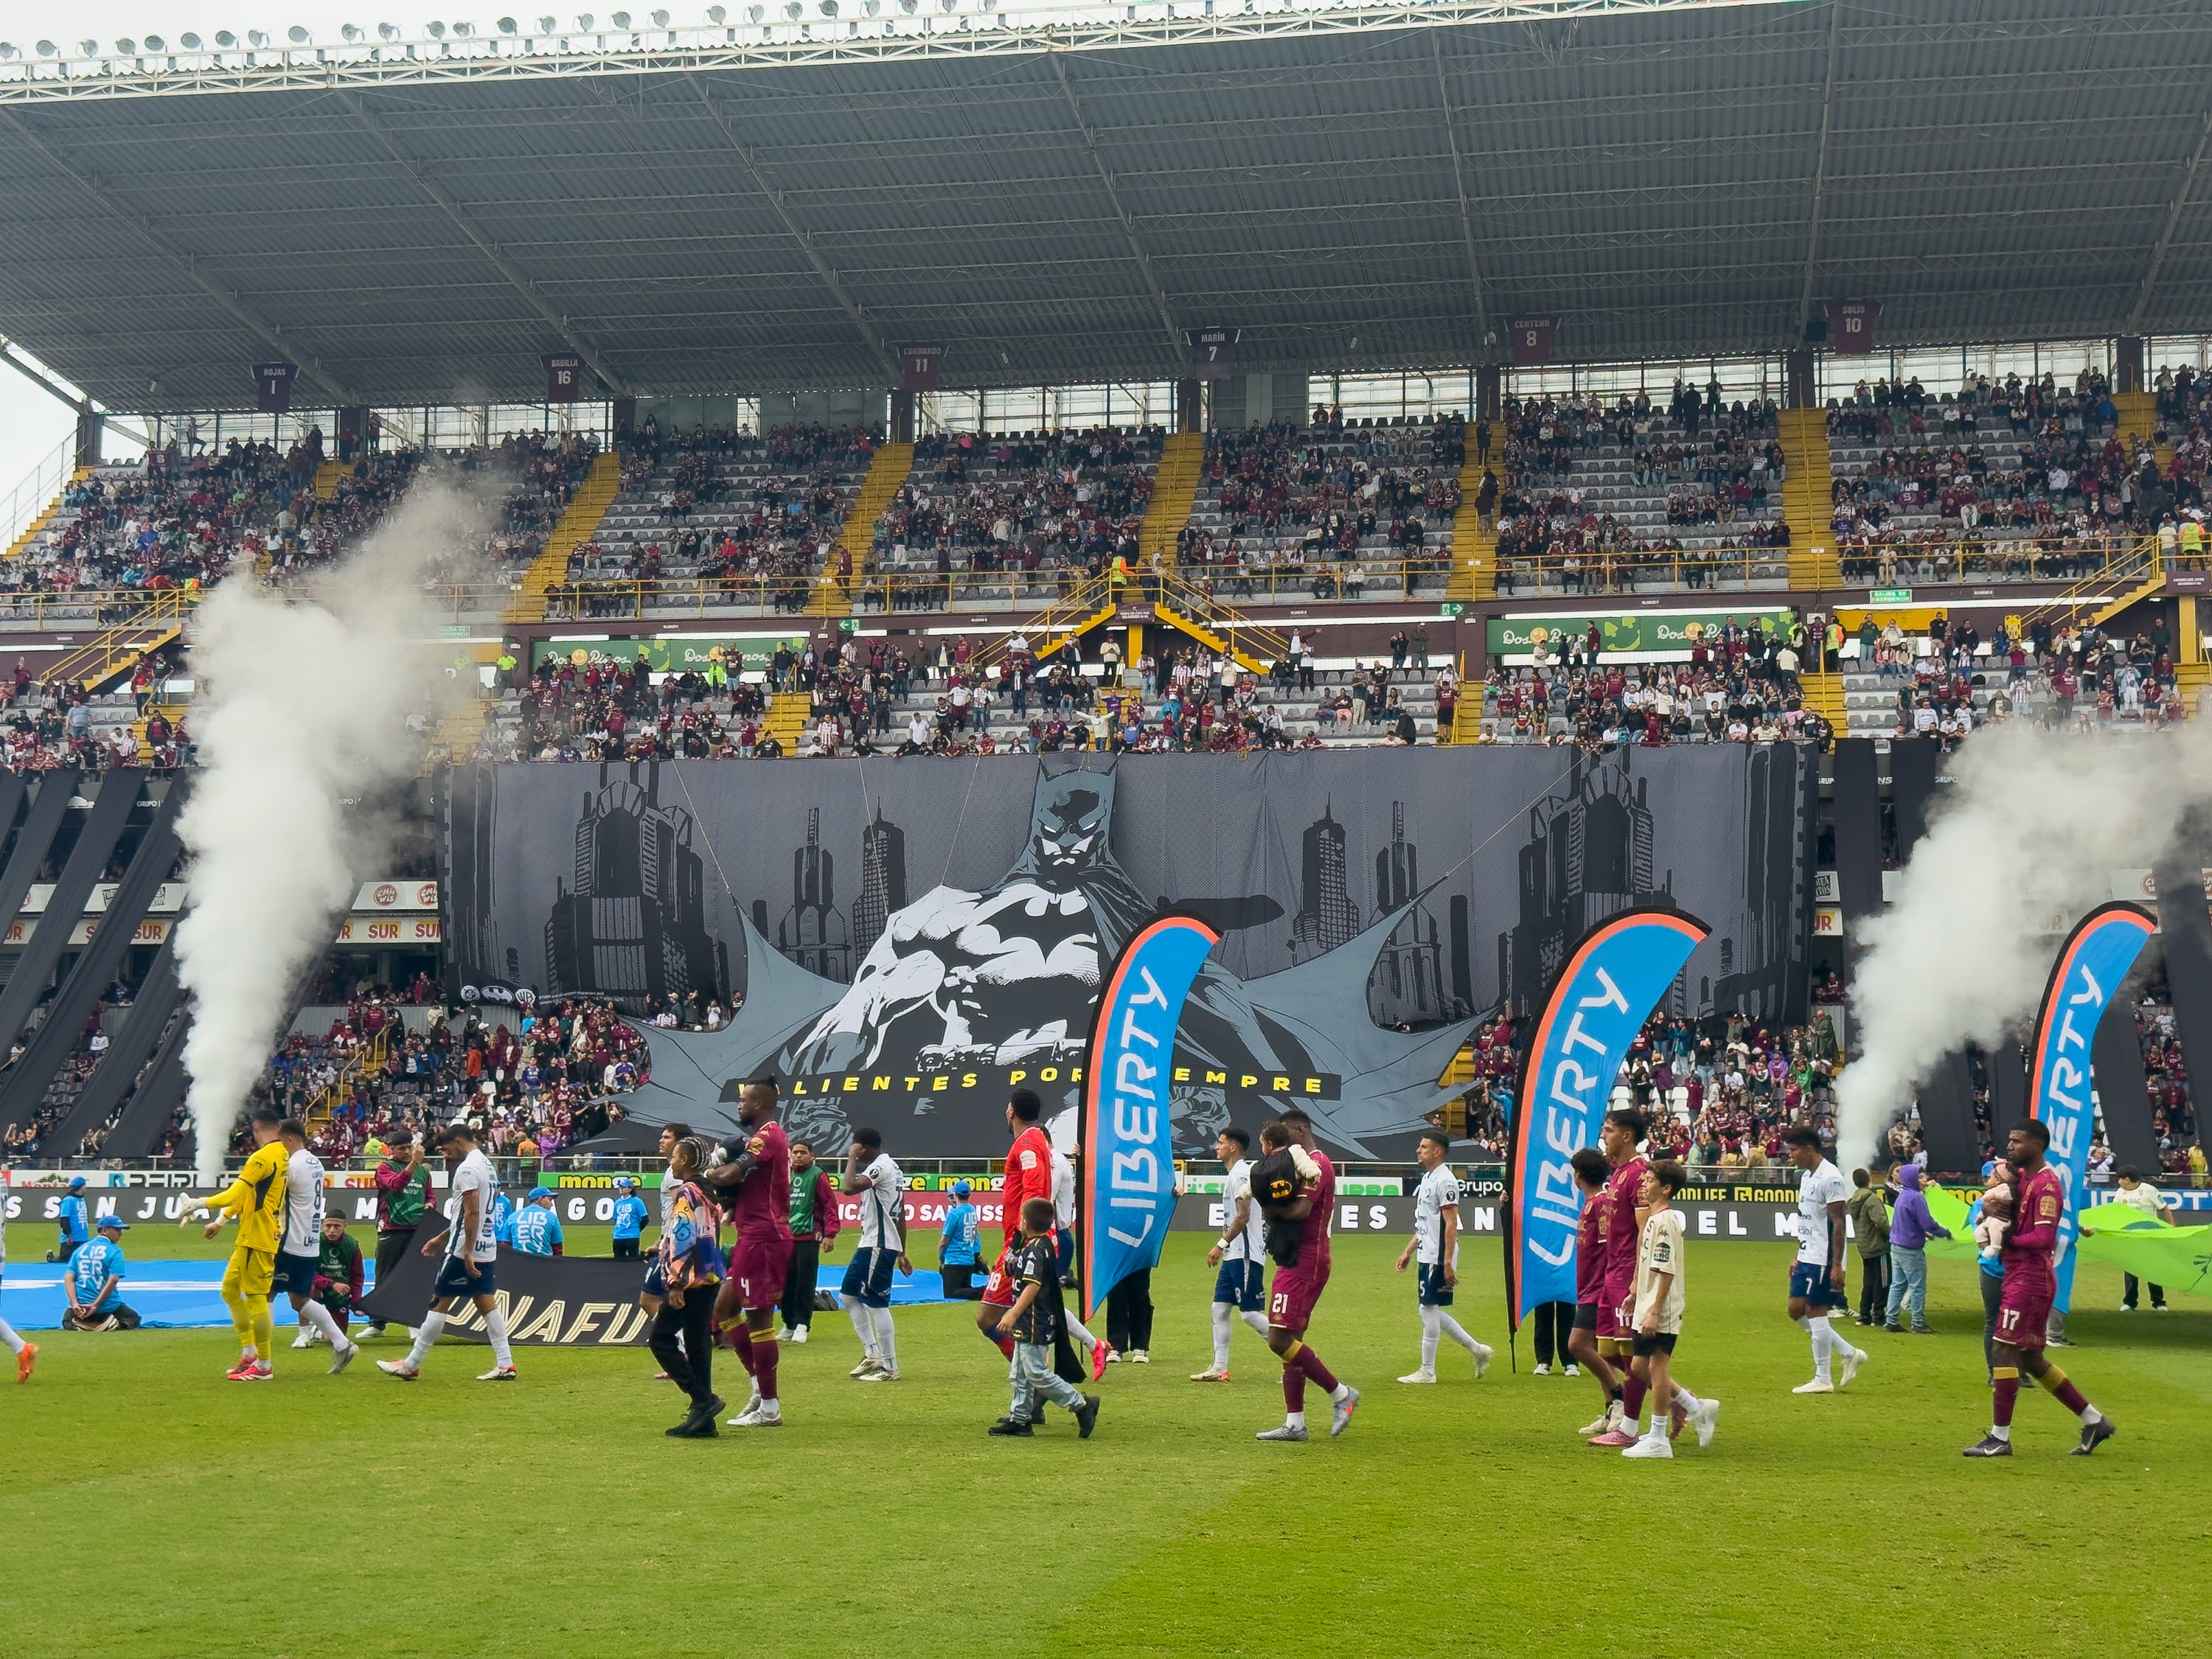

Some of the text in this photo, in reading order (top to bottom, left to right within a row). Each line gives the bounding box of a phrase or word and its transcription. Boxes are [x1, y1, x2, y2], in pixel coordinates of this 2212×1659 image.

[1846, 318, 1861, 333] 10
[1202, 331, 1225, 343] MARÍN
[1526, 330, 1537, 347] 8
[904, 347, 942, 355] CORONADO
[1208, 346, 1217, 361] 7
[264, 368, 286, 376] ROJAS
[916, 358, 928, 372] 11
[557, 370, 571, 385] 16
[1503, 630, 1532, 644] Dos
[1658, 625, 1687, 640] Dos
[548, 650, 568, 665] Do
[684, 649, 710, 662] Dos
[415, 922, 441, 939] SU
[1814, 914, 1832, 931] UR
[369, 923, 399, 939] SUR
[738, 1073, 978, 1095] LIENTES
[1175, 1068, 1321, 1093] EMPRE
[1108, 965, 1168, 1248] LIBERTY
[1528, 967, 1630, 1266] LIBERTY
[314, 1180, 321, 1210] 8
[44, 1195, 117, 1219] SN
[518, 1211, 547, 1225] LIB
[518, 1225, 546, 1240] ER
[79, 1244, 107, 1259] LIB
[78, 1259, 103, 1275] ER
[77, 1274, 104, 1290] TY
[741, 1277, 749, 1296] 4
[1806, 1277, 1813, 1295] 7
[1272, 1293, 1289, 1314] 21
[445, 1289, 649, 1343] UNAFU
[2002, 1309, 2020, 1331] 17
